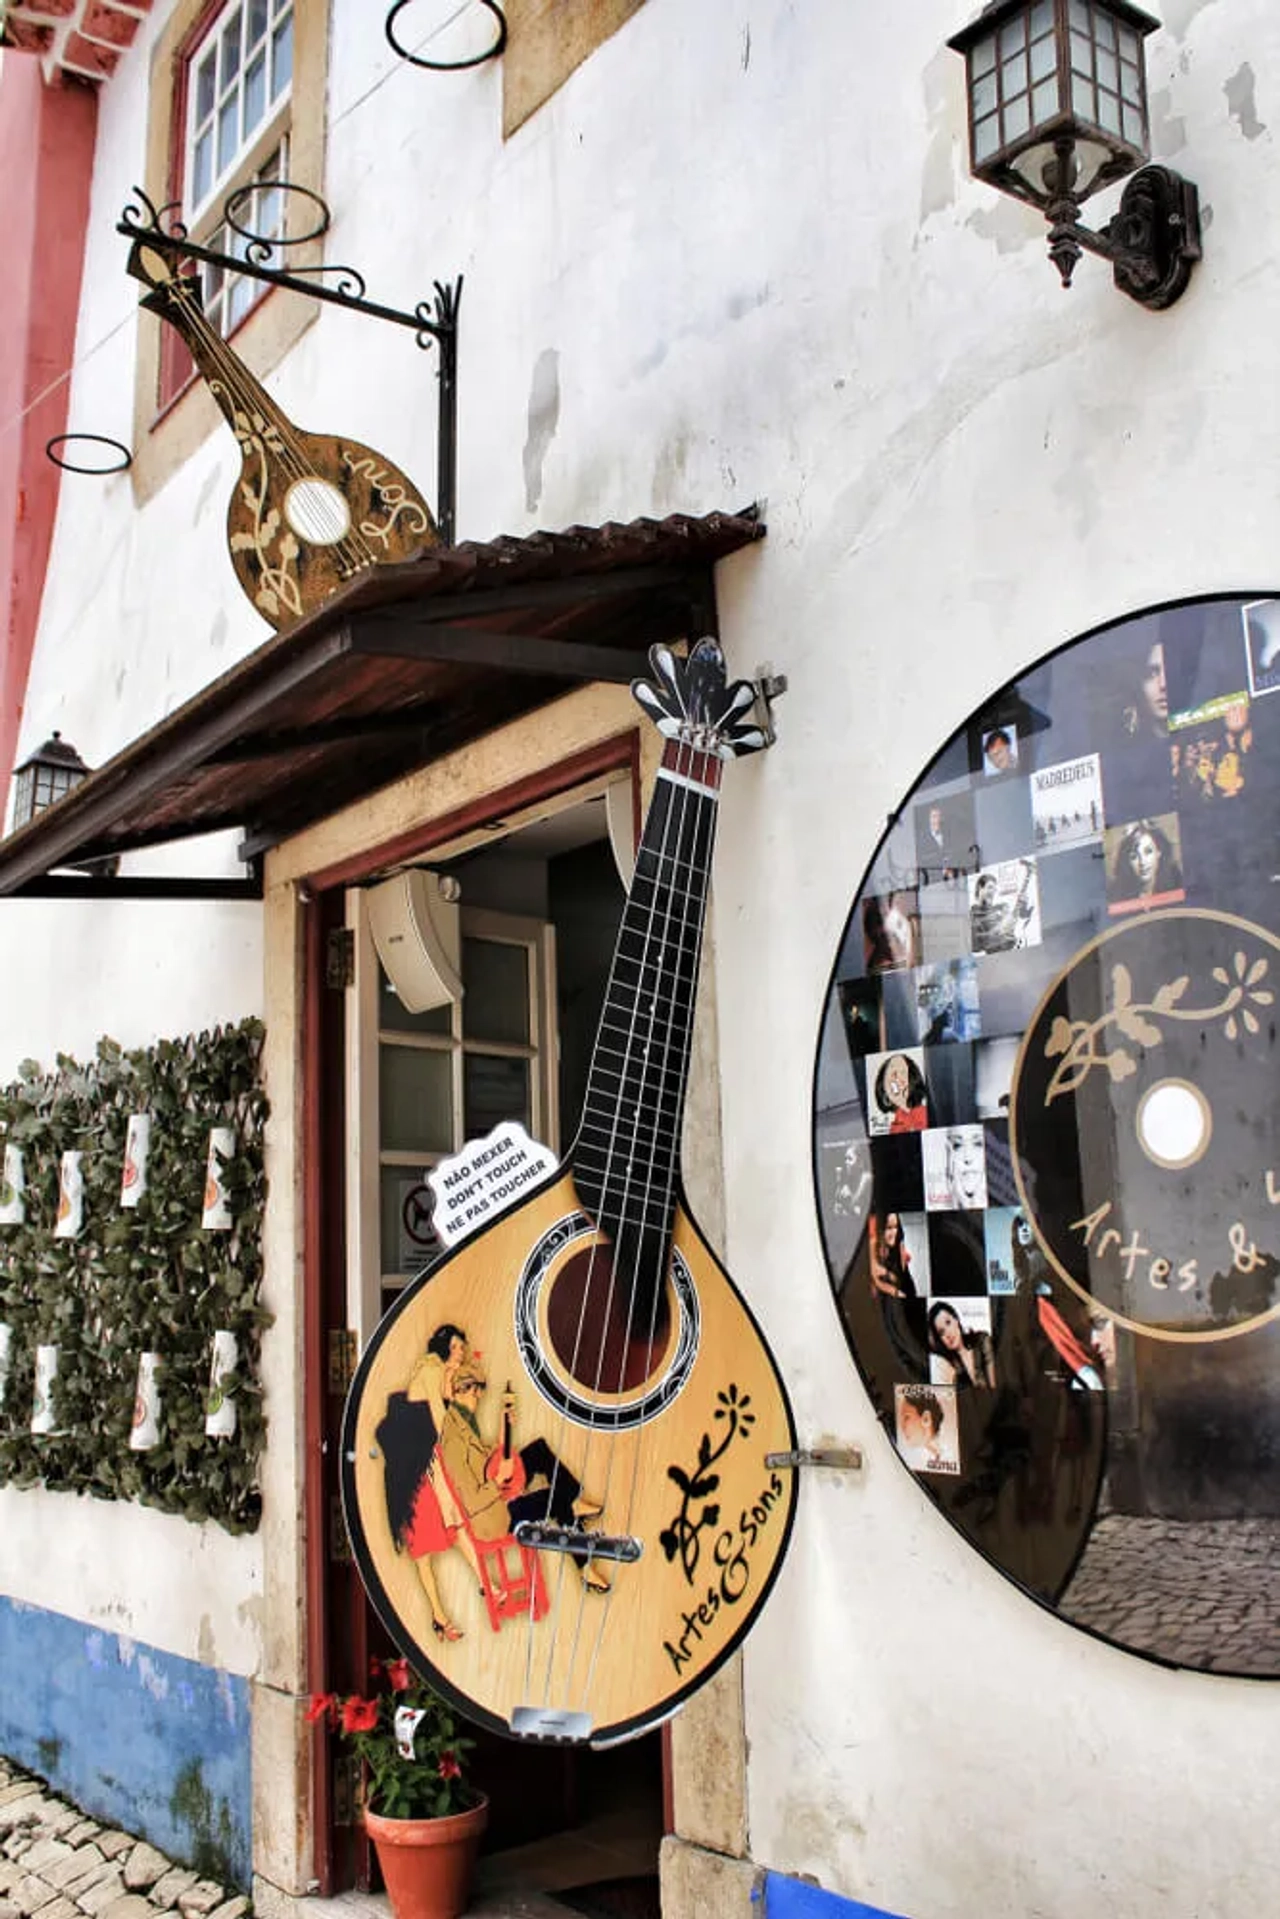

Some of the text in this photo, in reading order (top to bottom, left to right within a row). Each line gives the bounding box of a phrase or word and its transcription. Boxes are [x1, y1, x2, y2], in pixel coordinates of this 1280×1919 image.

[447, 1150, 527, 1210] DON'T TOUCH
[472, 1137, 514, 1170] MEXER
[446, 1159, 547, 1234] NE PAS TOUCHER
[1069, 1201, 1197, 1292] Artes
[1228, 1222, 1267, 1274] &
[663, 1473, 782, 1676] Artes & Sons
